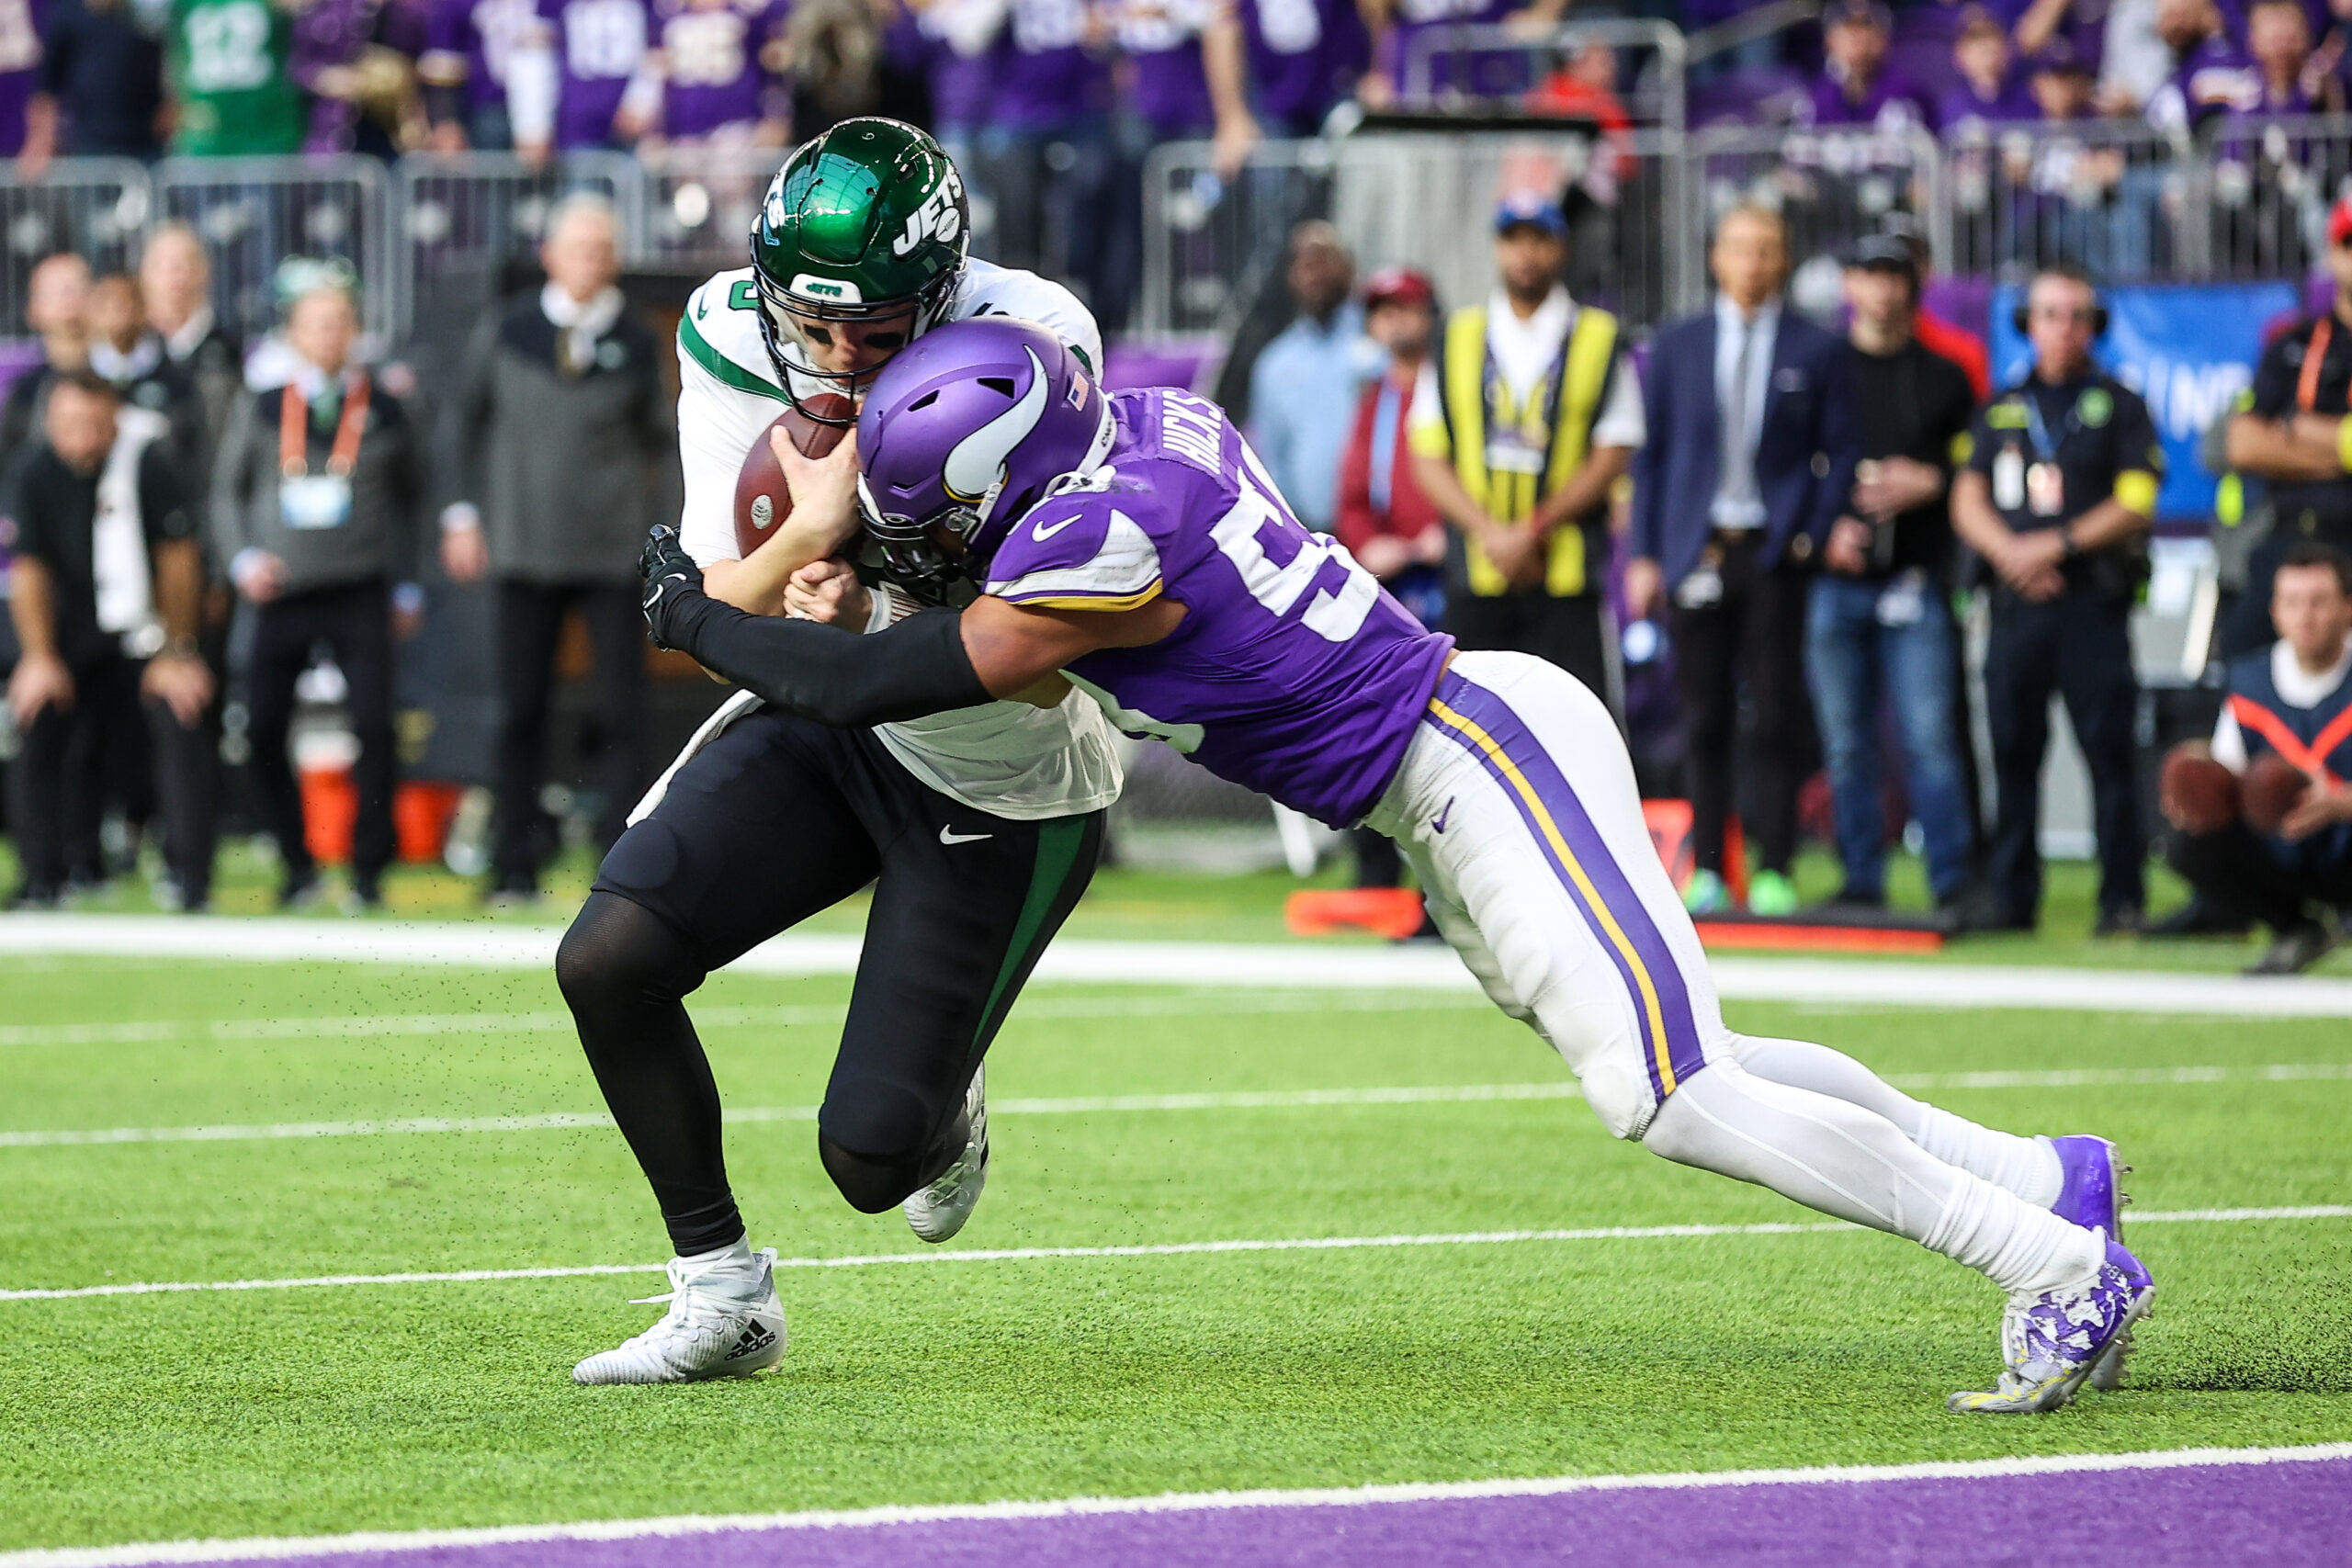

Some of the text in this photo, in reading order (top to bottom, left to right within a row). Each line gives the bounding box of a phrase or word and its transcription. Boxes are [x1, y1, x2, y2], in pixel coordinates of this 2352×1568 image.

[892, 163, 963, 255] JETS
[1161, 389, 1223, 476] HICKS
[723, 1331, 776, 1361] adidas
